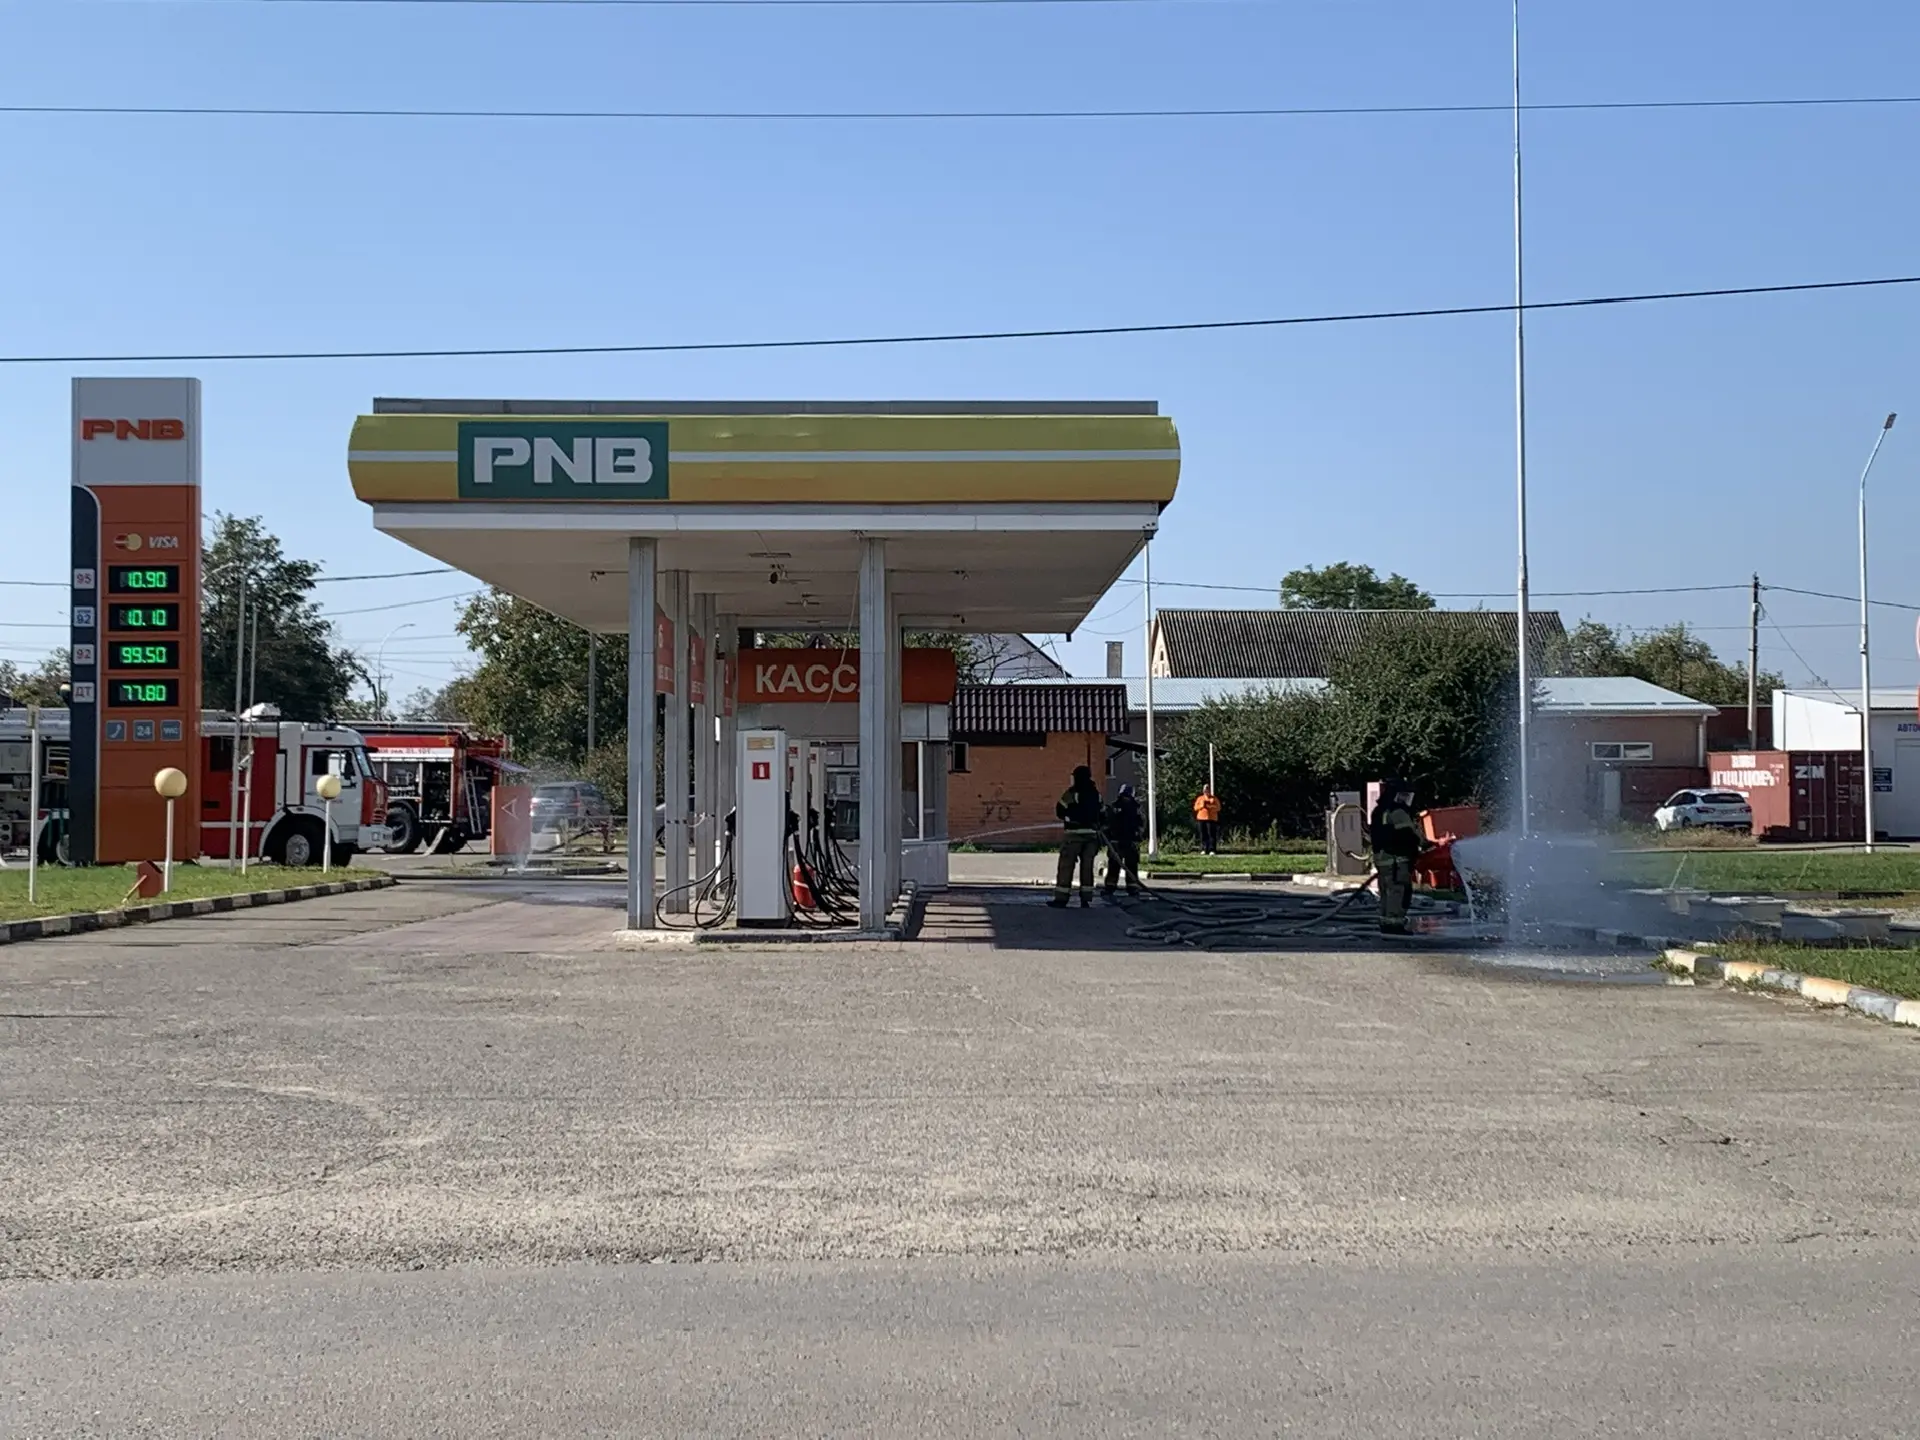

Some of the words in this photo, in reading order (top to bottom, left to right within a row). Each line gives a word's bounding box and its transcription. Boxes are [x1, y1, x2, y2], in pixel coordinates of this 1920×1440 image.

[82, 419, 184, 440] PNB
[474, 437, 653, 484] PNB
[148, 536, 179, 548] VISA
[76, 572, 92, 584] 95
[76, 613, 92, 625] 92
[76, 648, 92, 660] 92
[121, 646, 167, 663] 99.50
[756, 664, 861, 693] КАСС
[75, 686, 93, 698] ДТ
[122, 684, 167, 702] 77.80
[136, 725, 152, 737] 24
[1794, 765, 1825, 779] ZIM
